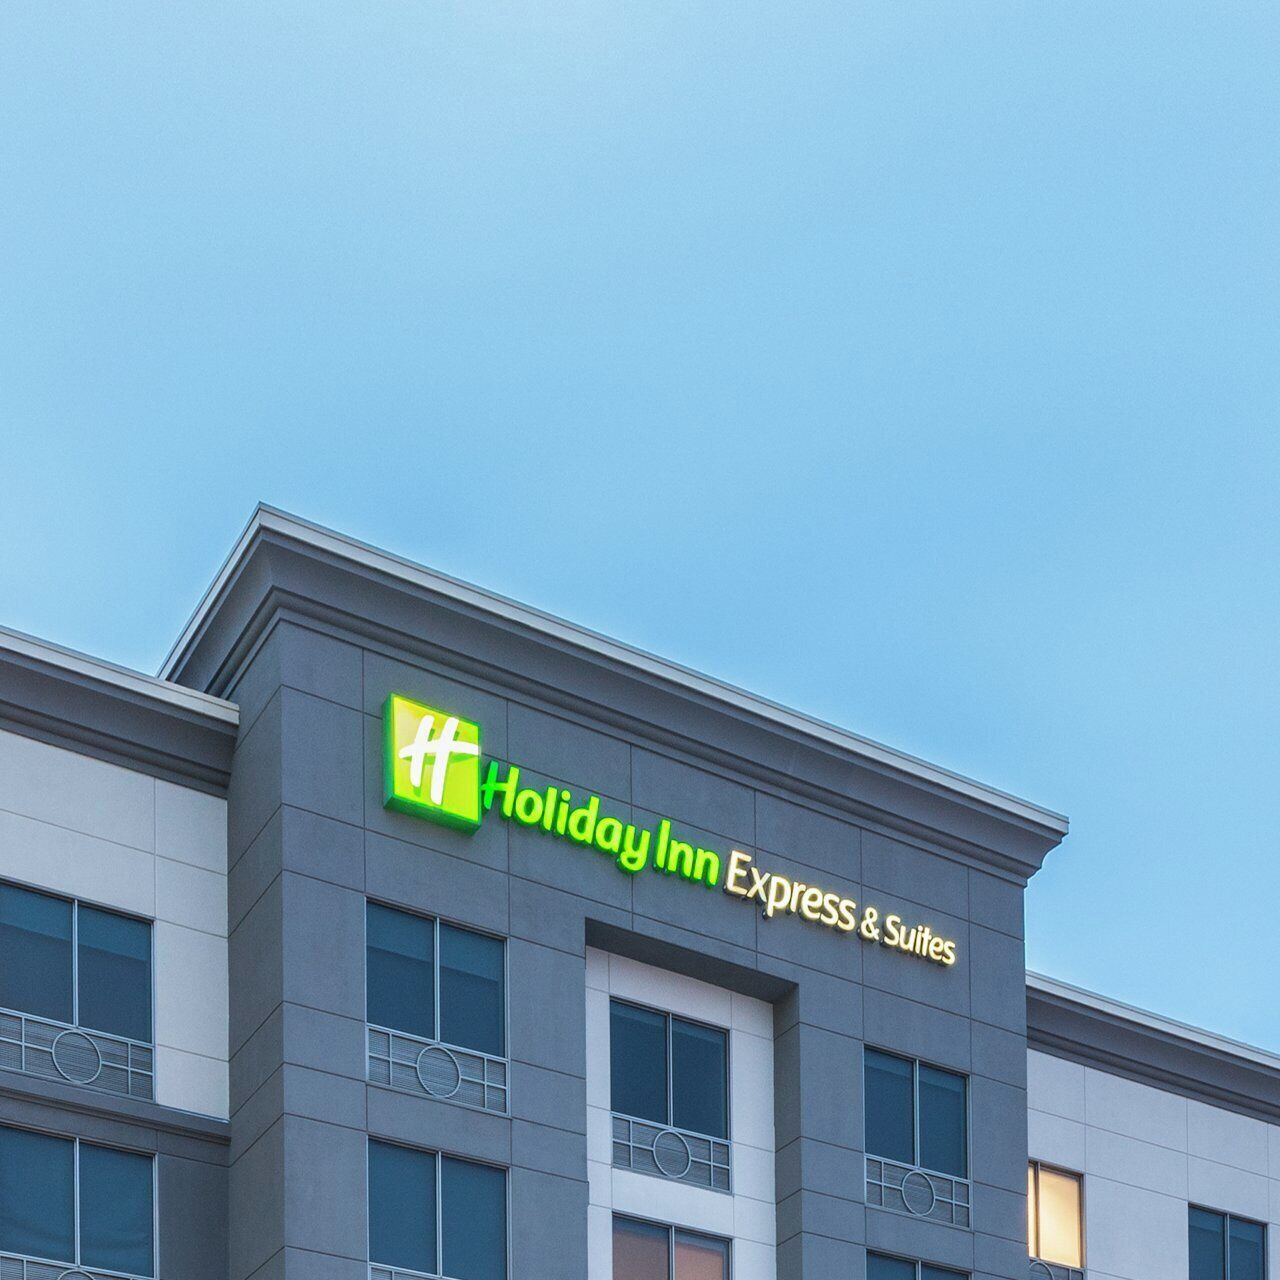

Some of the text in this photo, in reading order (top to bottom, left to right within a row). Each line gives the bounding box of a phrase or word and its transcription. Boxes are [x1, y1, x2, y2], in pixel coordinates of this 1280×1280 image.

[480, 759, 957, 966] Holiday Inn Express & Suites
